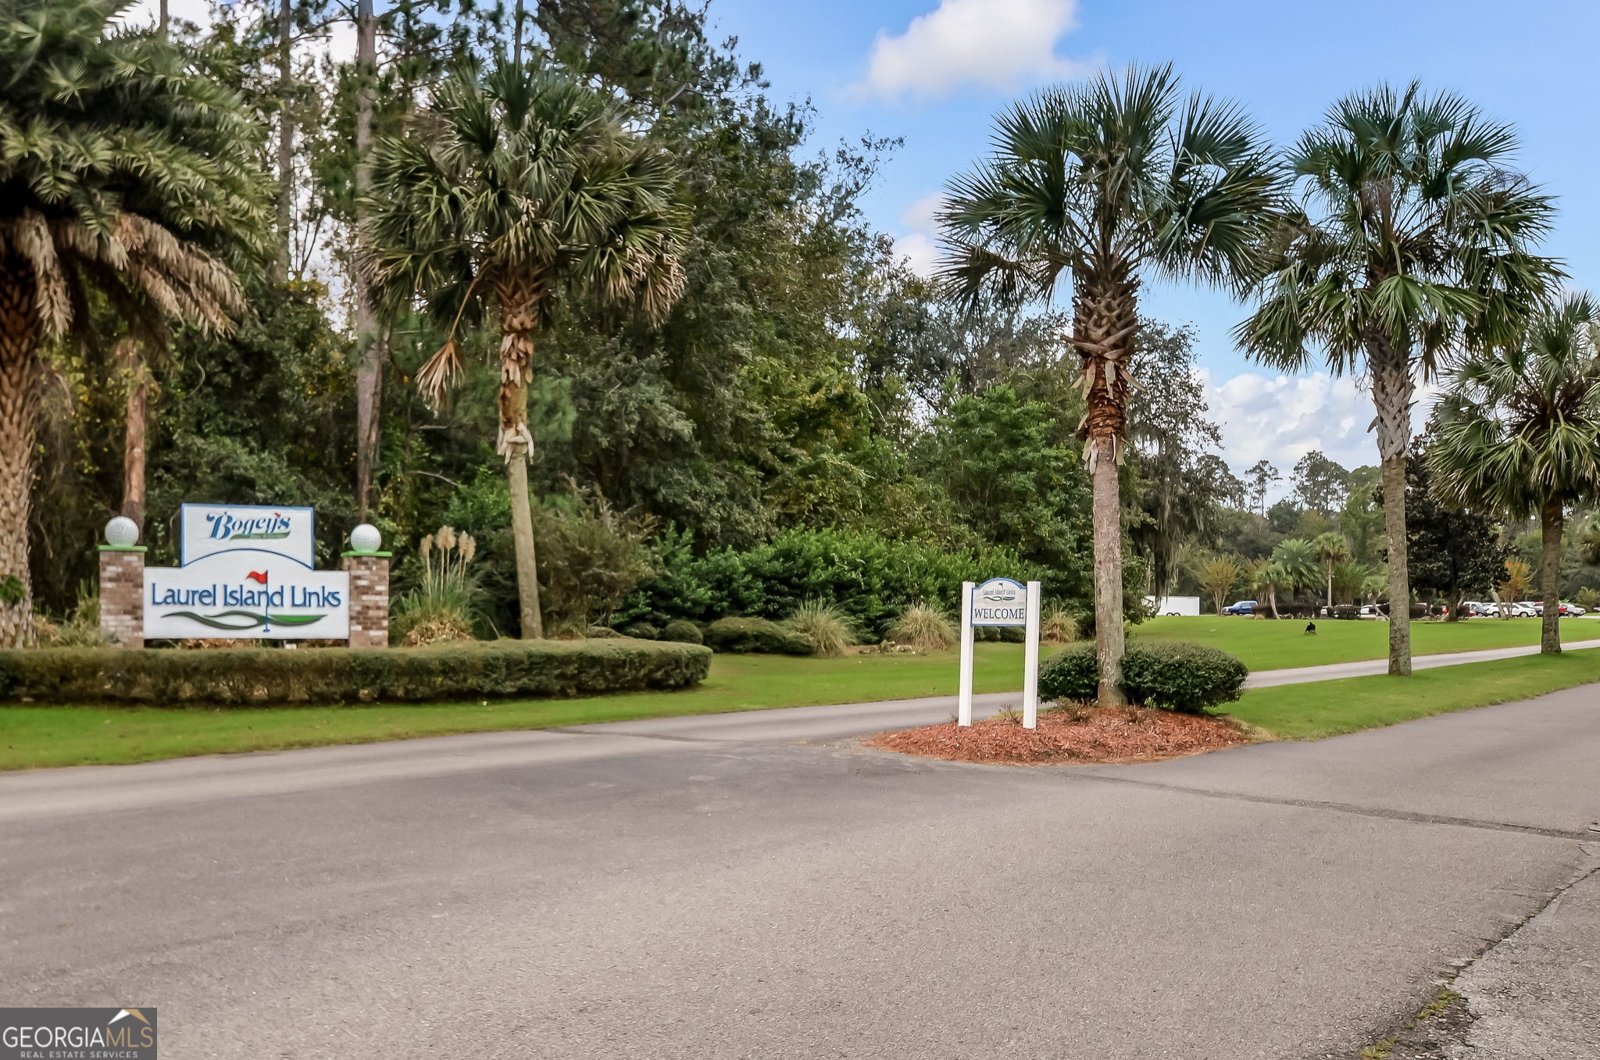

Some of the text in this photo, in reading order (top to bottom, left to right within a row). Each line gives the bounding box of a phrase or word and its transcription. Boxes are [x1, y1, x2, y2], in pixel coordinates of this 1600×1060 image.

[206, 511, 291, 540] Bogey's
[151, 582, 341, 608] Laurel Island Links
[974, 608, 1025, 620] WELCOME
